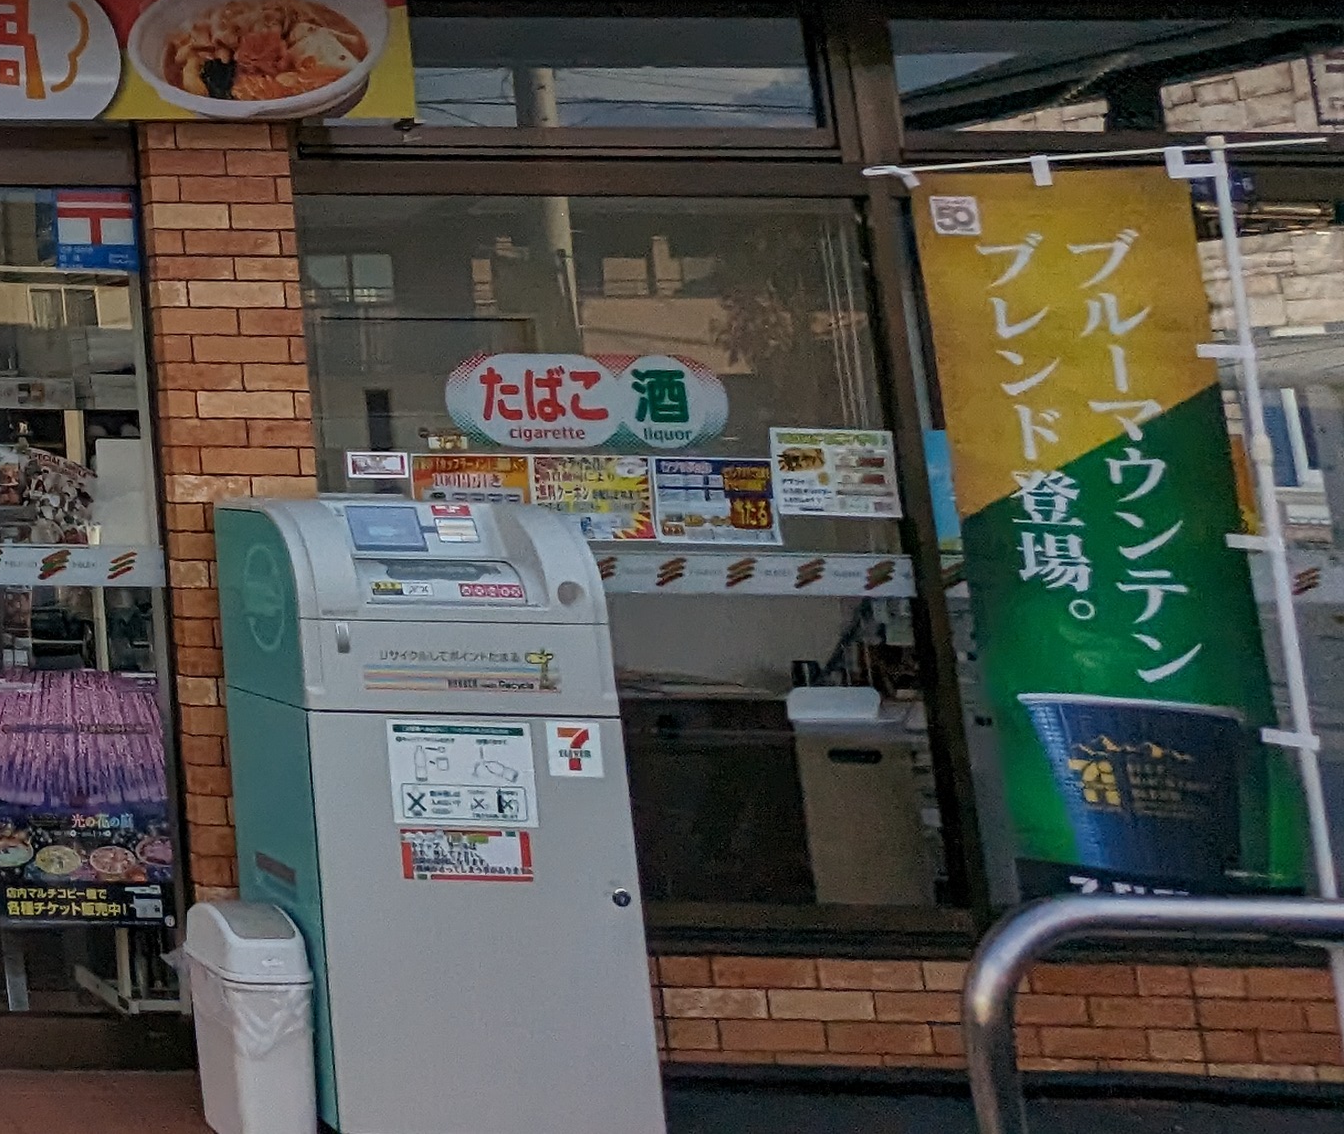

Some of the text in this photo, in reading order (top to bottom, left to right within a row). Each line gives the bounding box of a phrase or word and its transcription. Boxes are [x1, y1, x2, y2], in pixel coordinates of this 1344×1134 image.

[480, 366, 689, 424] たばこ 酒
[509, 426, 693, 443] cigarette liquor
[976, 233, 1096, 620] ブレンド登場。
[1067, 229, 1201, 683] ブルーマウンテン
